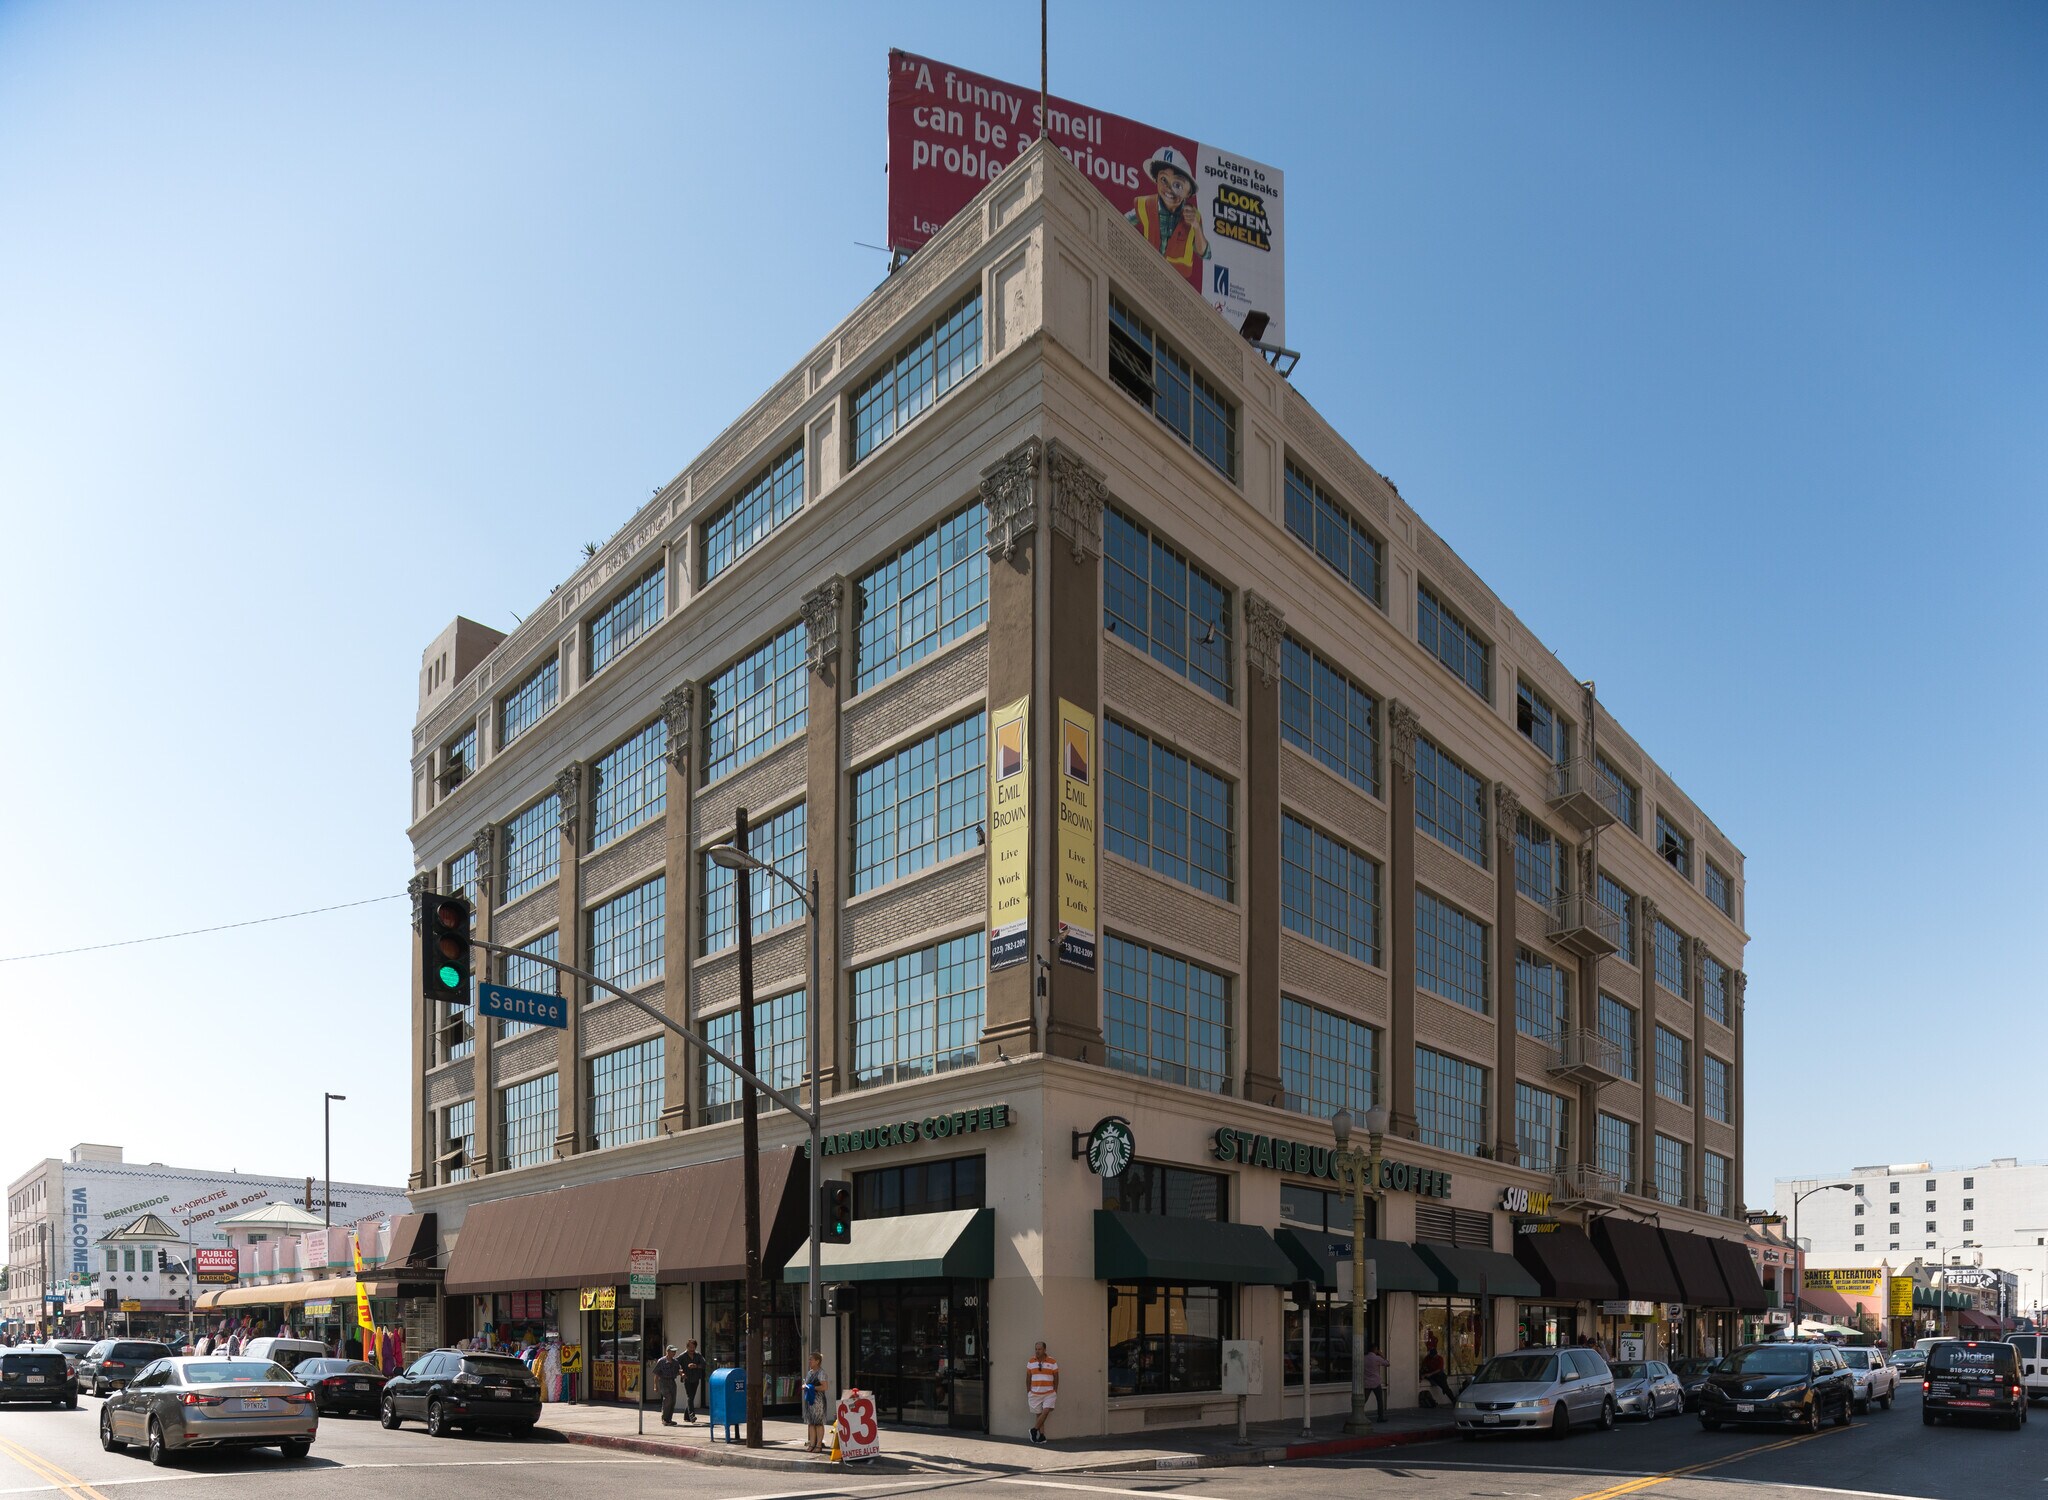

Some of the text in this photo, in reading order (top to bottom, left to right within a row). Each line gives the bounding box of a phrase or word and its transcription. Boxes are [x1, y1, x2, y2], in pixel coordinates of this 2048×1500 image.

[945, 71, 1022, 125] funny
[1032, 104, 1102, 145] smell
[912, 139, 1008, 180] proble
[913, 106, 1140, 189] can be a erious
[1204, 165, 1279, 198] spot gas leaks
[1217, 155, 1266, 182] Learn to
[1220, 188, 1265, 216] LOOK.
[1214, 202, 1271, 236] LISTEN.
[1215, 219, 1270, 250] SMELL.
[998, 783, 1021, 805] EMIL
[1065, 779, 1088, 808] EMIL
[993, 804, 1026, 830] BROWN
[1060, 801, 1093, 833] BROWN
[1000, 848, 1019, 862] Live
[1068, 848, 1087, 865] Live
[997, 872, 1021, 887] Work
[1065, 872, 1089, 890] Work
[998, 896, 1021, 912] Lofts
[1066, 896, 1089, 914] Lofts
[489, 991, 558, 1019] Santee
[921, 1104, 1006, 1141] COFFEE
[1379, 1158, 1453, 1200] COFFEE
[102, 1195, 170, 1221] BIENVENIDOS
[182, 1190, 268, 1227] DOBRO NAM DOSLI
[1502, 1186, 1553, 1216] SUBWAY
[72, 1187, 88, 1273] WELCOME
[1518, 1223, 1560, 1234] SUBWAY
[1749, 1215, 1780, 1225] SUBWAY
[198, 1257, 237, 1265] PARKING
[201, 1250, 233, 1258] PUBLIC
[1804, 1269, 1882, 1280] SANTEE ALTERATIONS
[964, 1296, 979, 1307] 300
[561, 1366, 583, 1374] SHOES
[837, 1398, 878, 1448] $3
[842, 1446, 880, 1458] SANTEE ALLEY
